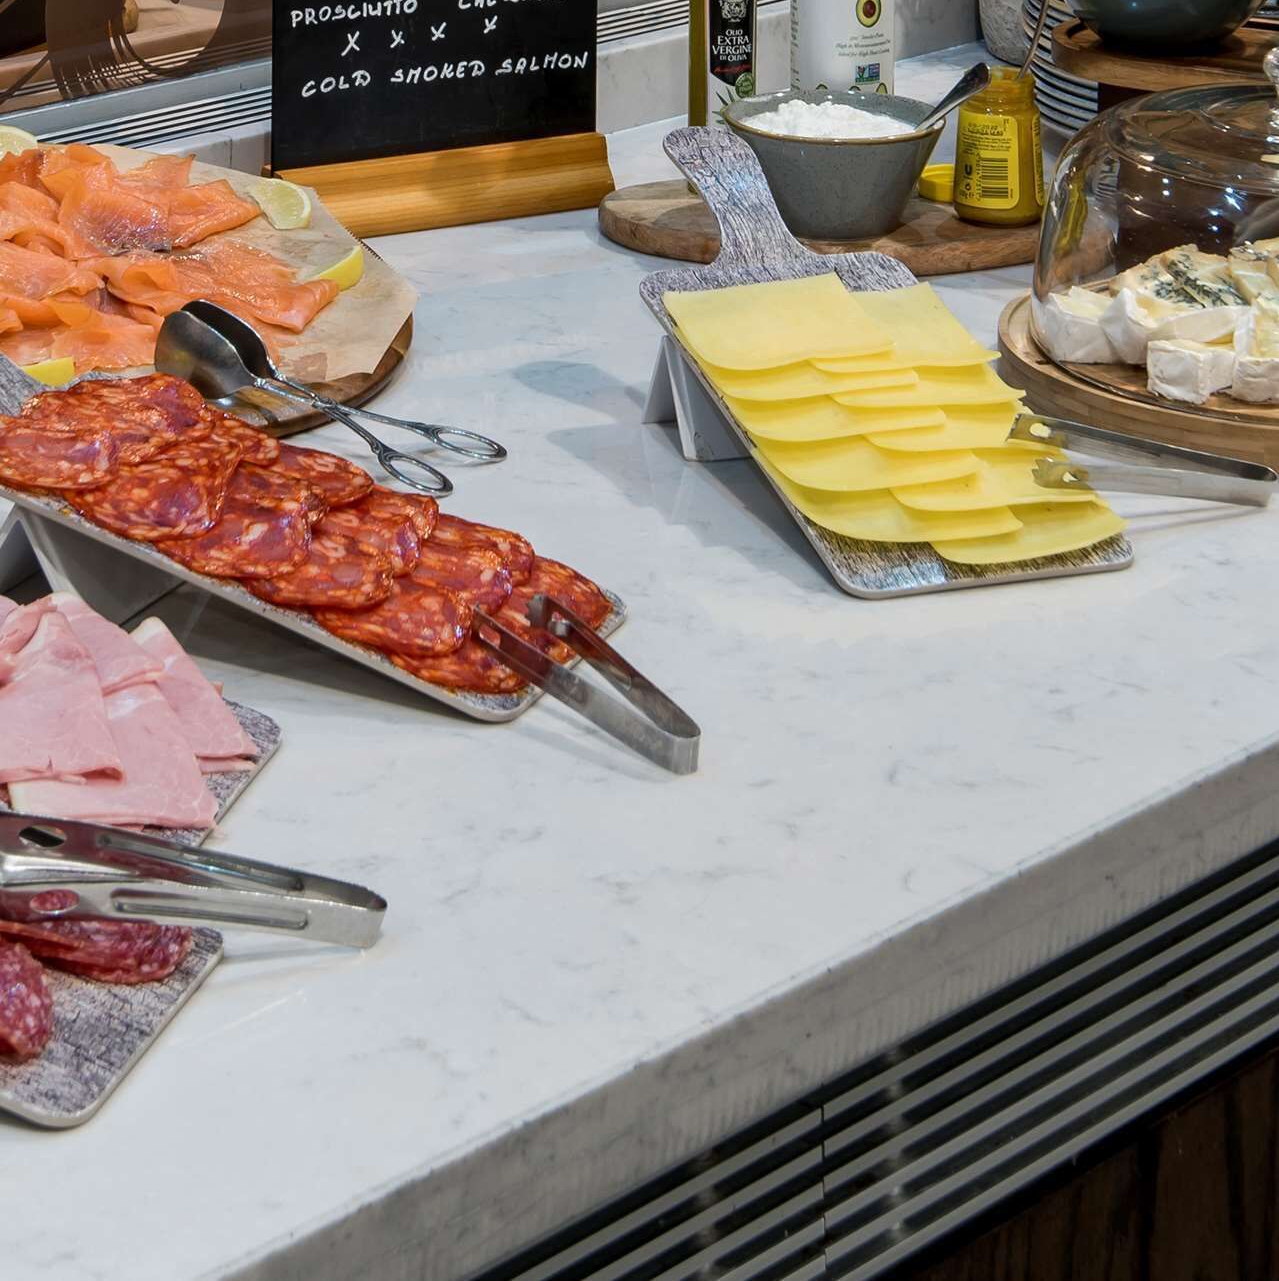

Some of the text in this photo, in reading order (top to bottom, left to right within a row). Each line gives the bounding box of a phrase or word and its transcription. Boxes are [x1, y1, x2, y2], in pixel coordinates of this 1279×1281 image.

[725, 29, 743, 37] OLIO
[717, 35, 750, 46] EXTRA
[712, 43, 752, 55] VERGINE
[727, 54, 748, 62] OLIVA
[301, 51, 589, 98] COLD SMOKED SALMON
